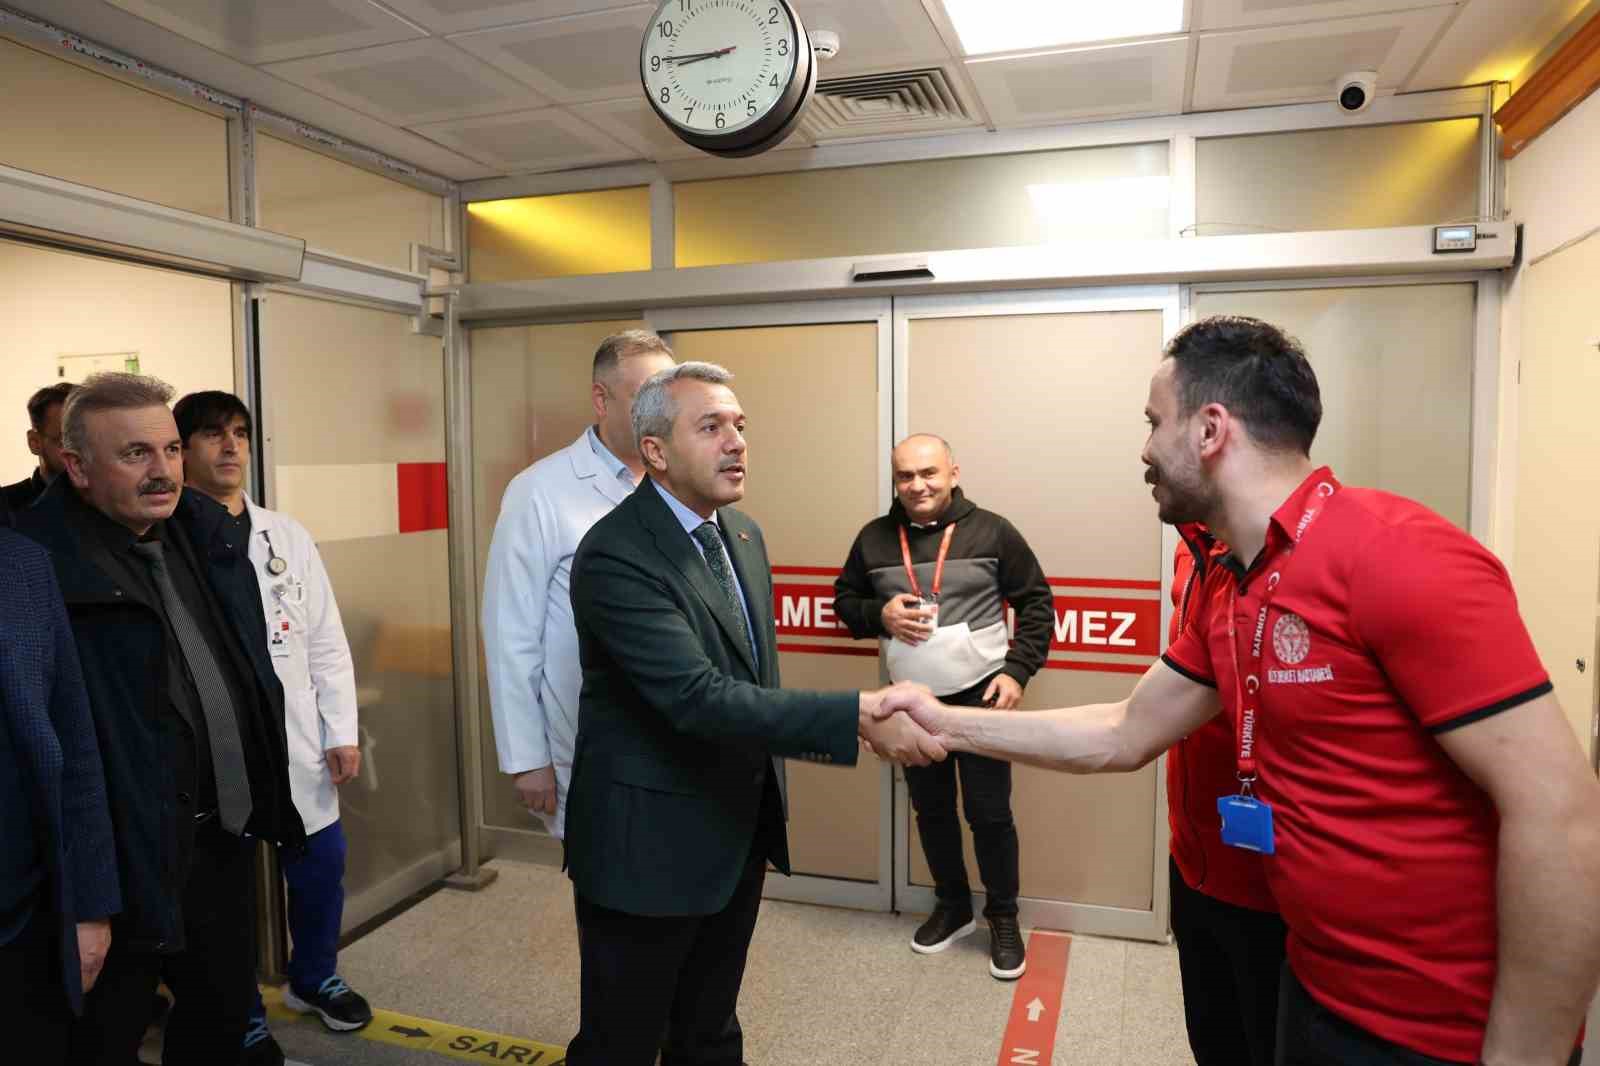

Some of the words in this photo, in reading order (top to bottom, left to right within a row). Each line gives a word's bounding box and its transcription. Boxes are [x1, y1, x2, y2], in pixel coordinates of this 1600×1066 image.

[768, 7, 779, 24] 2
[657, 20, 673, 38] 10
[777, 39, 788, 56] 3
[651, 55, 661, 72] 9
[768, 73, 779, 89] 4
[660, 87, 671, 104] 8
[683, 107, 693, 124] 7
[747, 100, 757, 117] 5
[715, 112, 725, 129] 6
[775, 595, 848, 629] ME
[1240, 709, 1255, 758] TÜRKİYE
[448, 1035, 545, 1065] SARI
